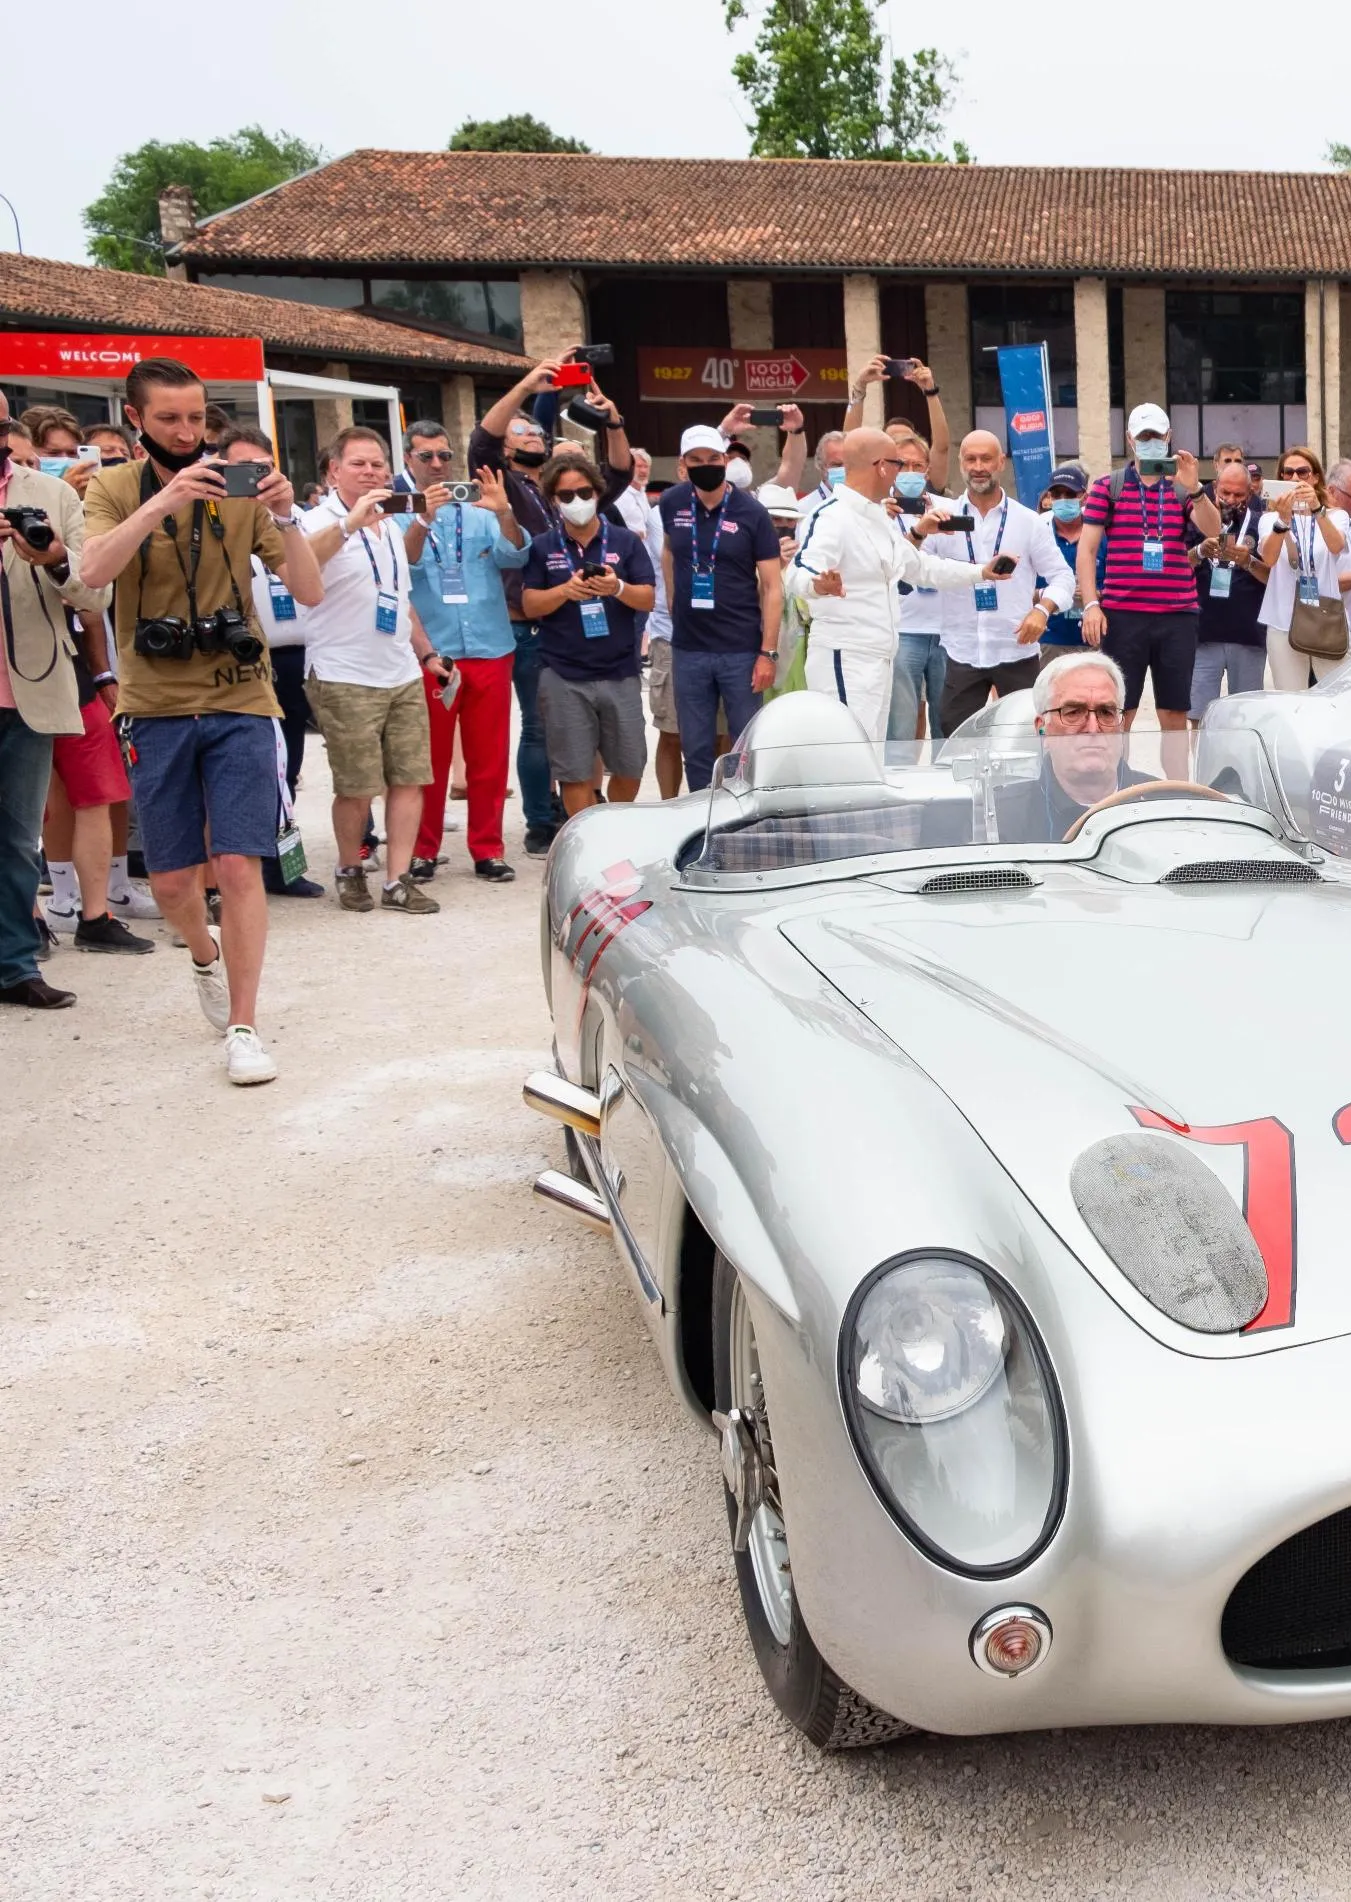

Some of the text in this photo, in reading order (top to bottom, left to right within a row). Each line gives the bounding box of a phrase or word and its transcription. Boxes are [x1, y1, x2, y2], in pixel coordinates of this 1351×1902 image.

[59, 351, 141, 362] WELCOME
[653, 367, 693, 380] 1927
[750, 362, 794, 375] 1000
[749, 374, 797, 388] MIGLIA
[1333, 758, 1350, 793] 3
